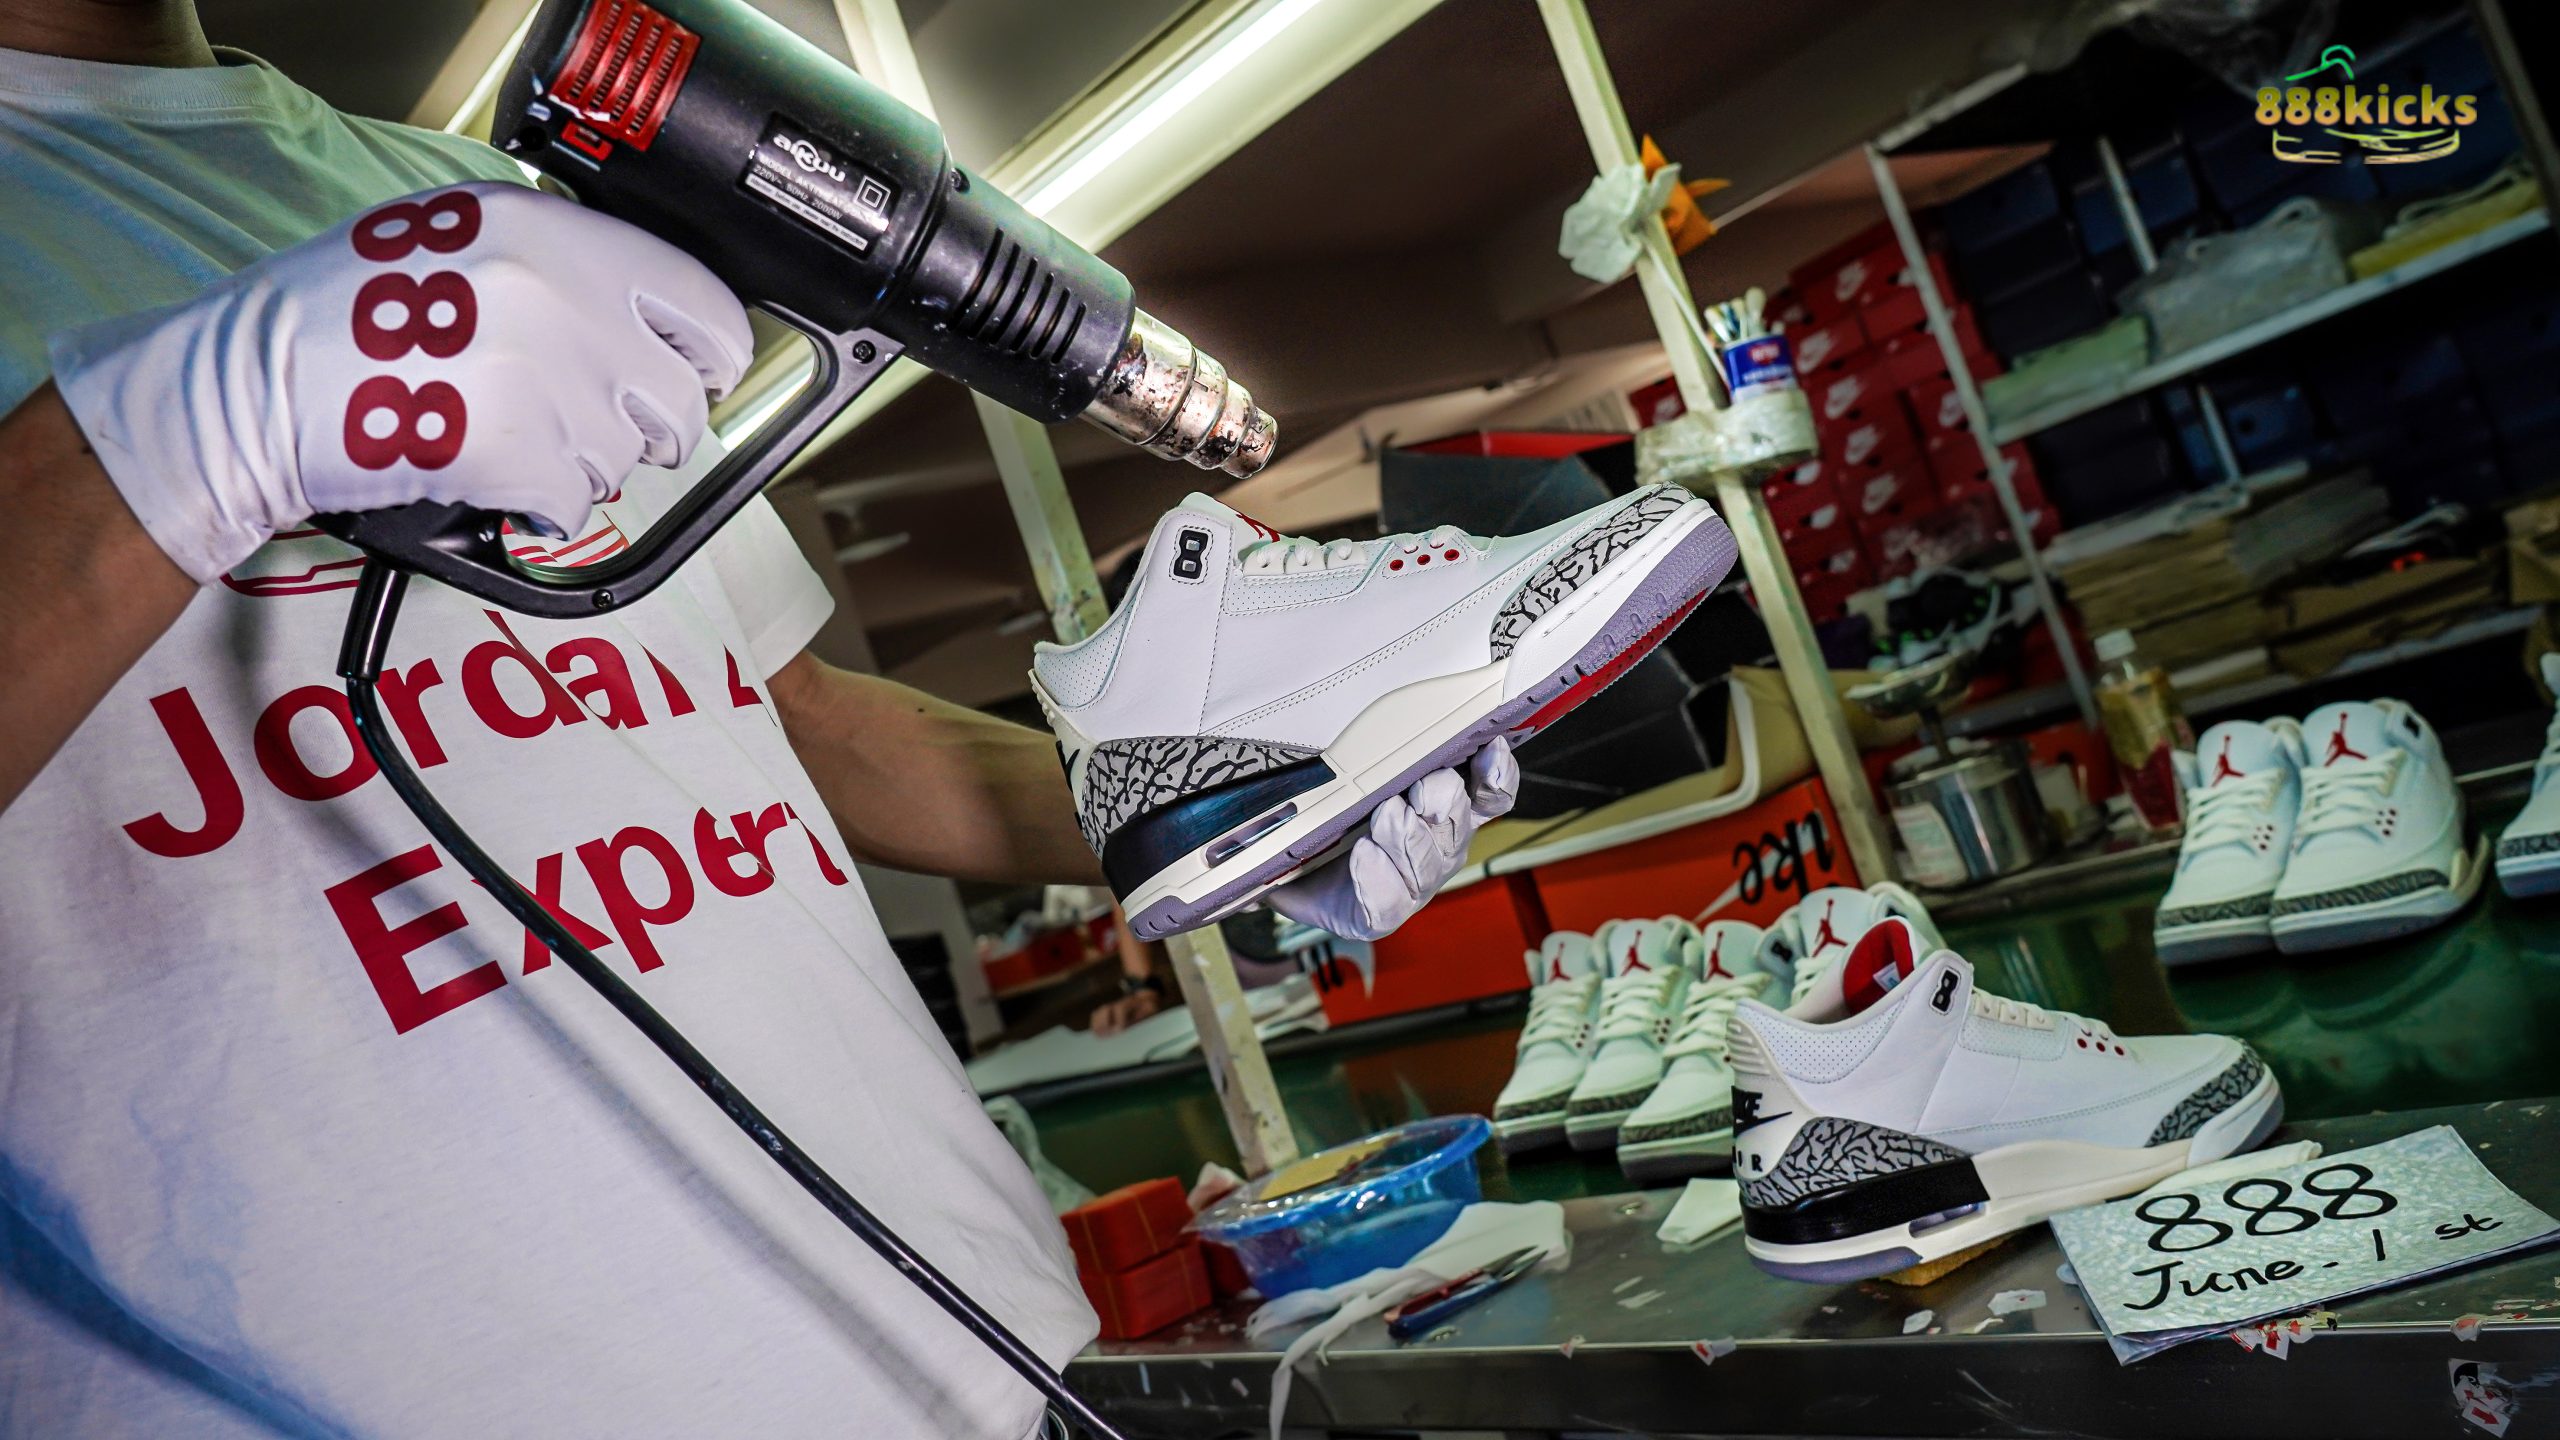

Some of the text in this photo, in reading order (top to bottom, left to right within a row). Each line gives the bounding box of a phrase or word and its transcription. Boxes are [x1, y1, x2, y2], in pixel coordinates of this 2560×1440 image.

[344, 190, 483, 472] 888
[1731, 1145, 1763, 1174] IR
[2134, 1162, 2399, 1253] 888
